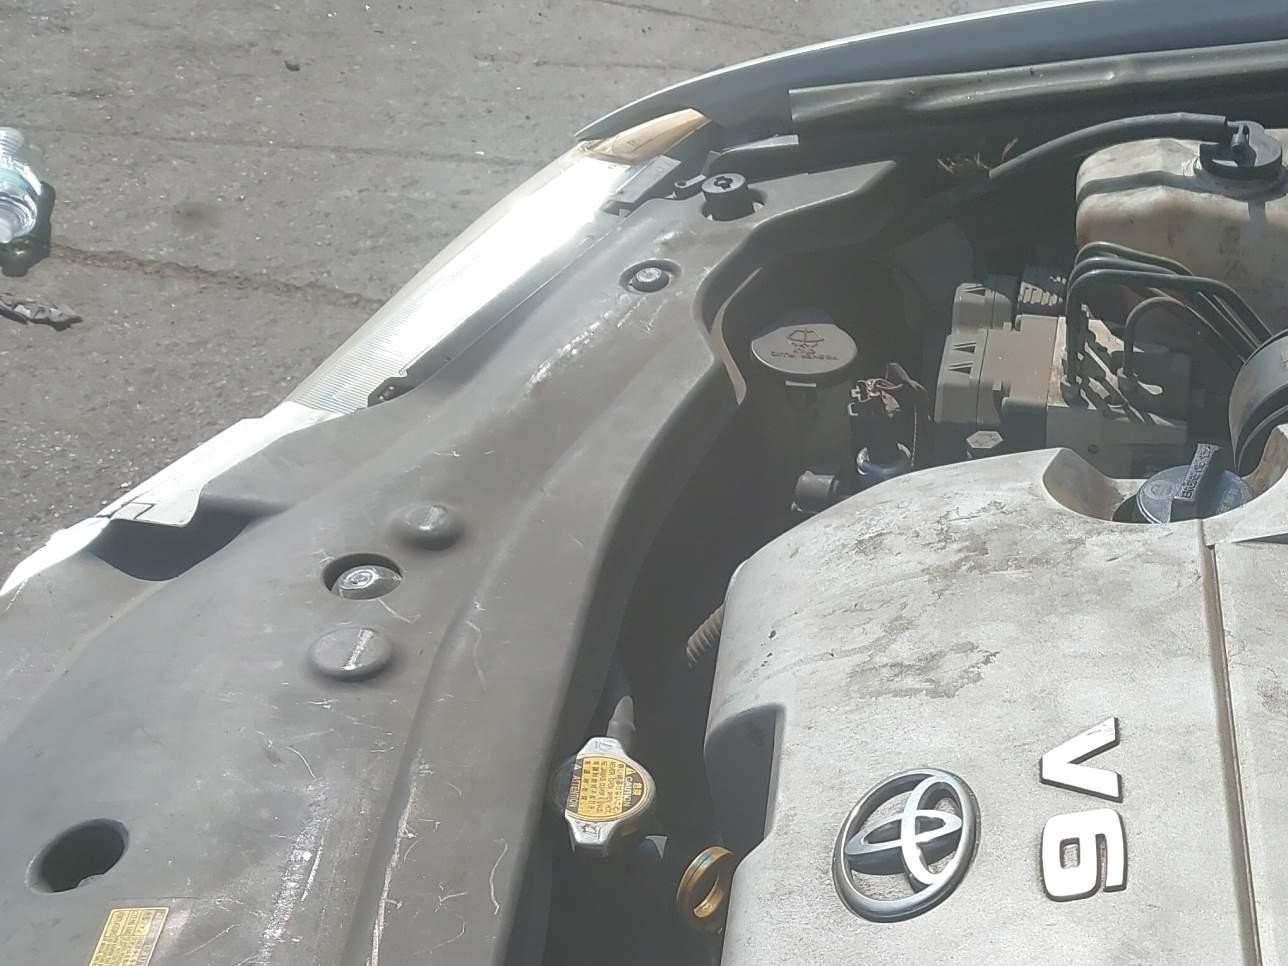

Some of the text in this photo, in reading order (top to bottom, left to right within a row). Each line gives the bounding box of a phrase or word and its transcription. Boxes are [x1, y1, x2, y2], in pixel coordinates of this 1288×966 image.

[568, 775, 582, 808] ATTENTION
[623, 776, 634, 807] CAUTION
[1038, 716, 1129, 903] V6
